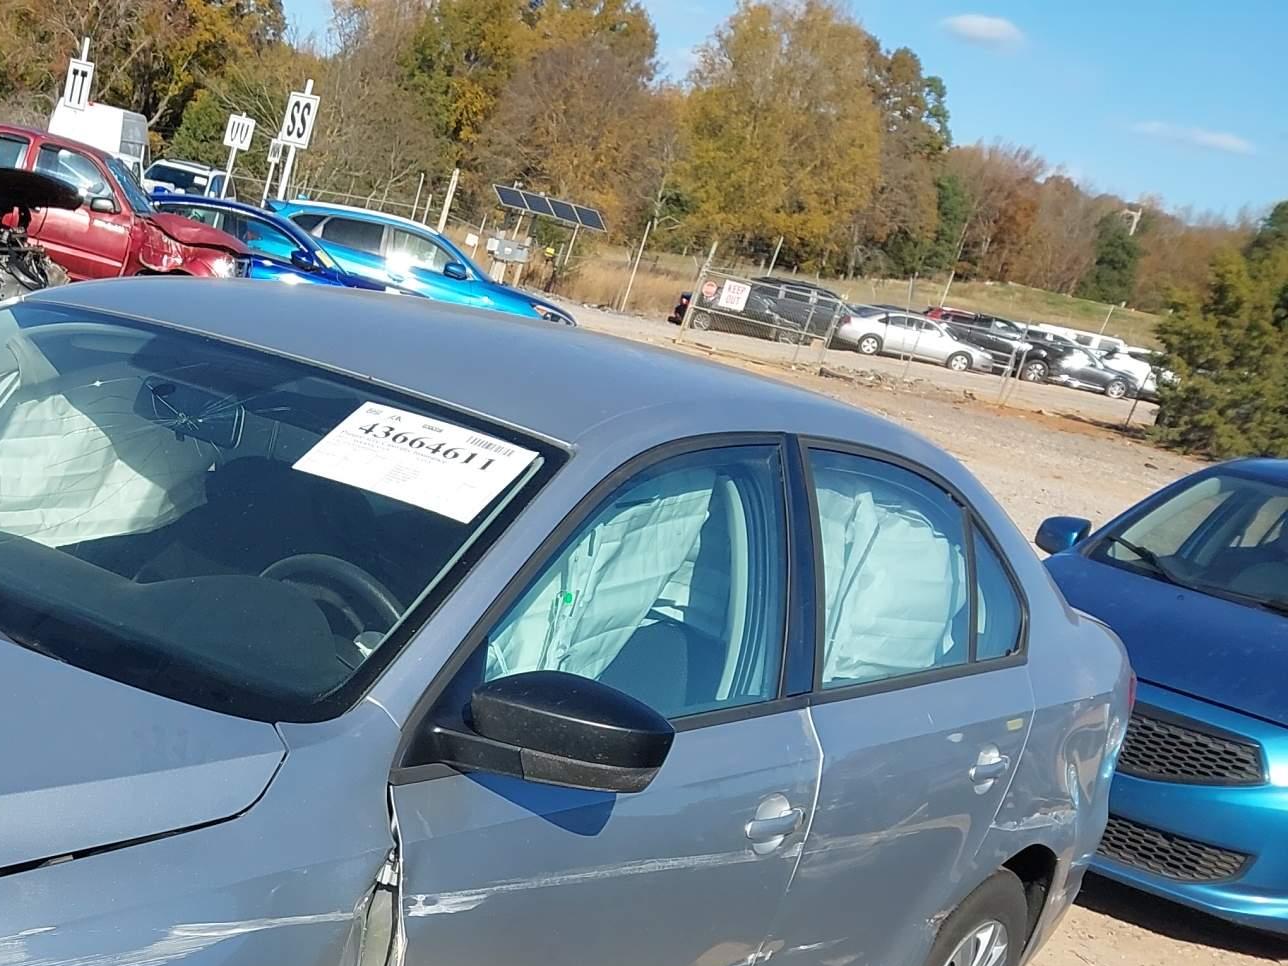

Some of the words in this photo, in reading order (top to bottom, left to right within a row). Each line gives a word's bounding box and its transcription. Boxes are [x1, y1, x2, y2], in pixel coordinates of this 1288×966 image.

[69, 68, 88, 105] TT
[230, 120, 250, 144] UU
[286, 100, 312, 139] SS
[725, 294, 742, 305] OUT
[727, 284, 747, 295] KEEP
[358, 422, 497, 471] 43664611
